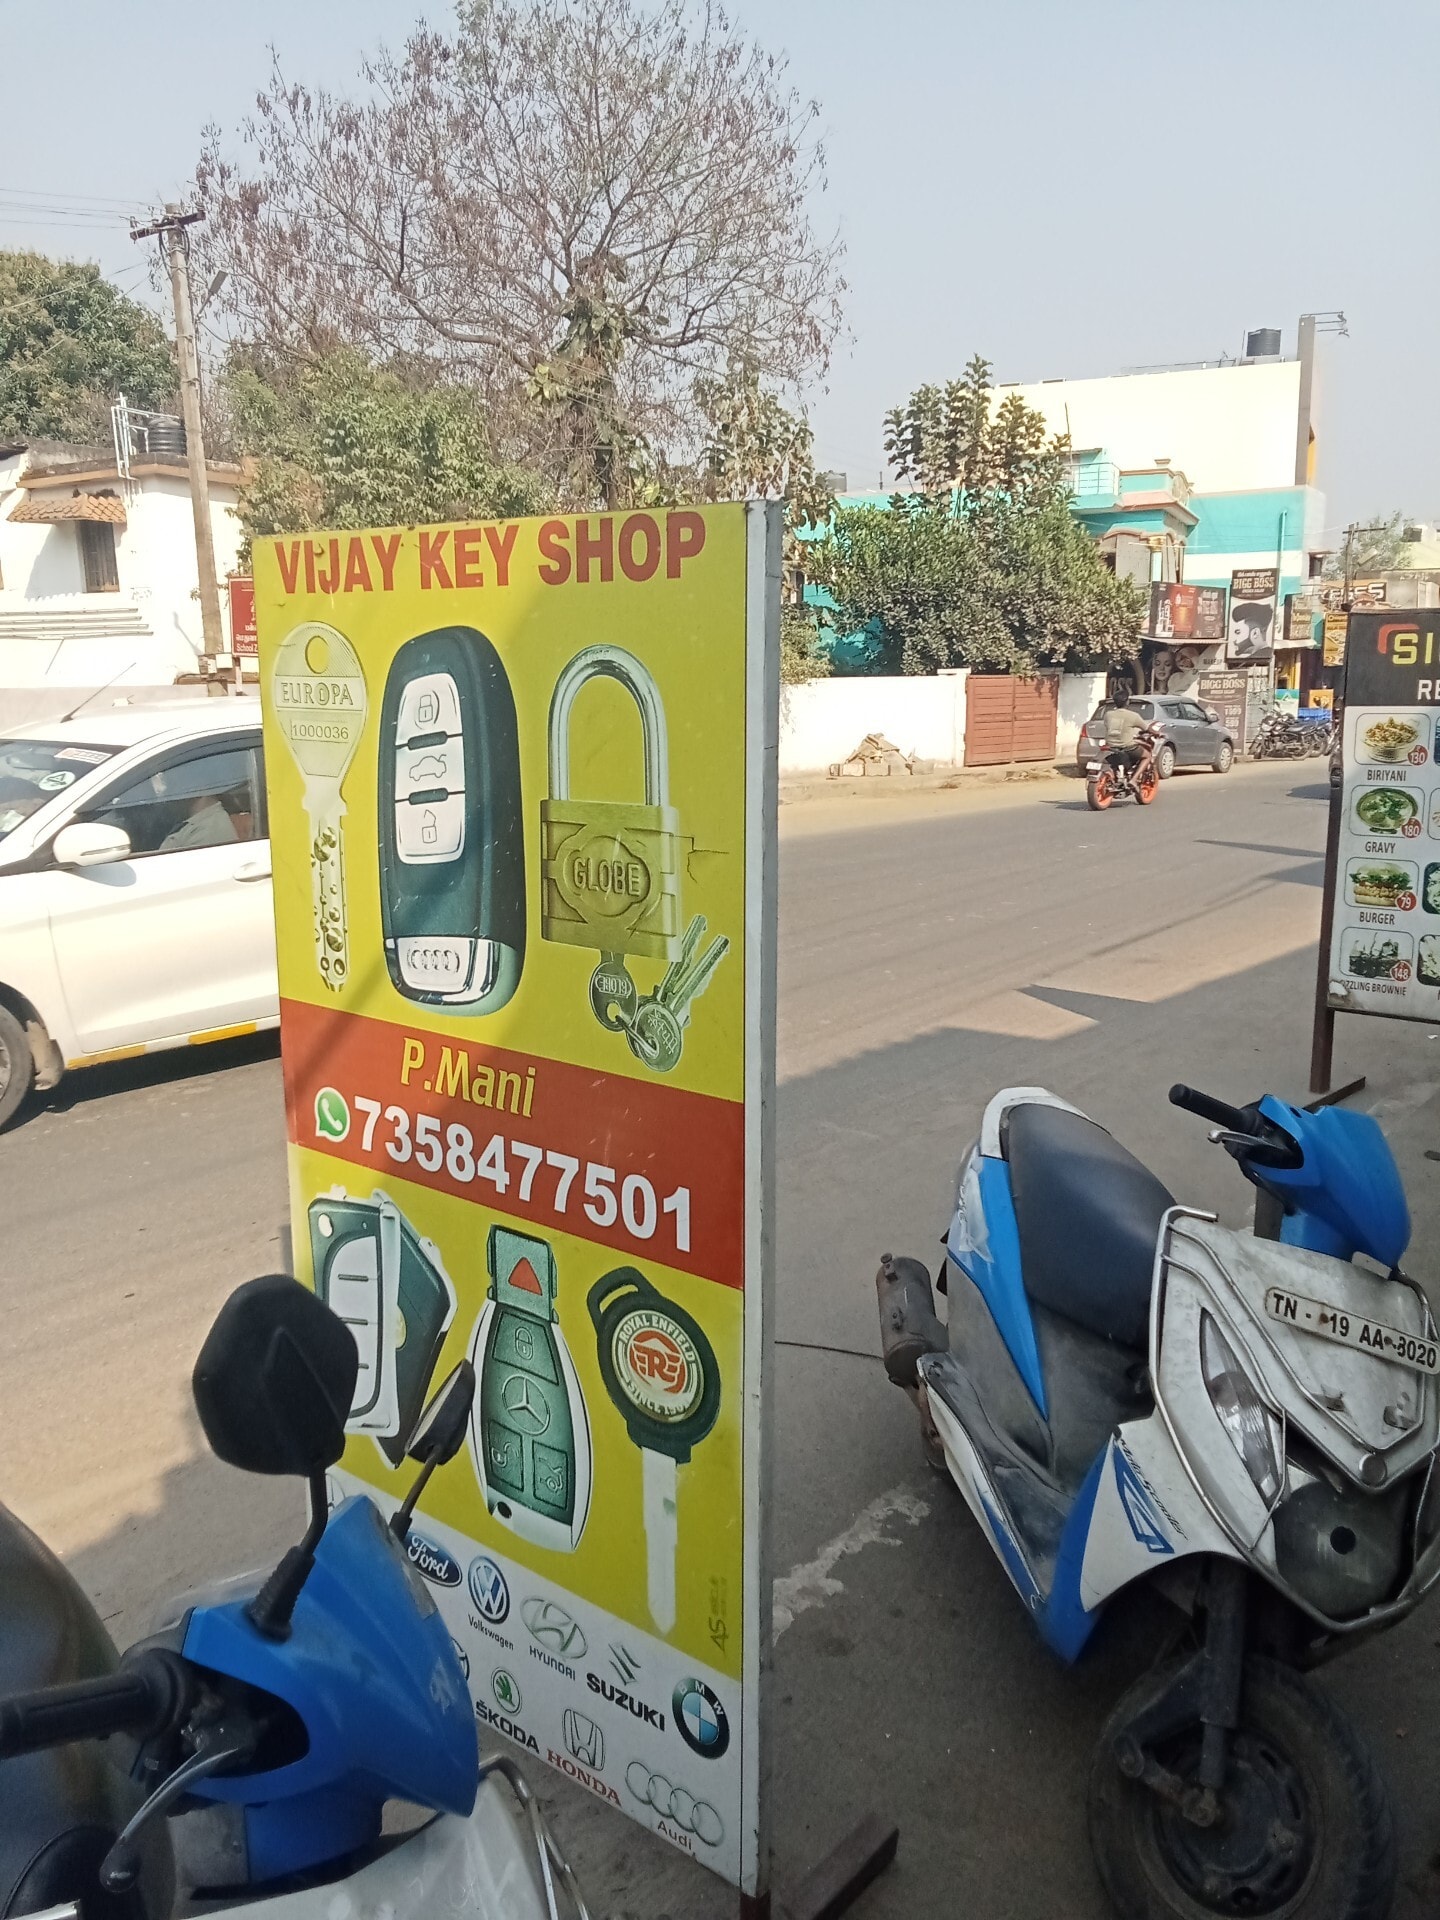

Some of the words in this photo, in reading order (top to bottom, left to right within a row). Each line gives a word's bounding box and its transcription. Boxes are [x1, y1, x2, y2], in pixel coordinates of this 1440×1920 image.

[274, 537, 401, 594] VIJAY
[420, 526, 517, 588] KEY
[539, 512, 705, 584] SHOP
[281, 682, 354, 706] EUROPA
[1200, 679, 1222, 690] BIGG
[1222, 678, 1246, 689] BOSS
[292, 724, 350, 741] 1000036
[1411, 751, 1426, 761] 130
[1367, 769, 1407, 782] BIRIYANI
[1365, 841, 1396, 854] GRAVY
[1404, 824, 1420, 836] 180
[574, 856, 641, 897] GLOBE
[1359, 911, 1396, 925] BURGER
[1400, 897, 1412, 909] 79
[1371, 982, 1407, 996] BROWNIE
[401, 1037, 537, 1118] P.Mani
[354, 1095, 691, 1253] 7358477501
[1273, 1293, 1298, 1320] TN
[1329, 1312, 1350, 1337] 19
[618, 1315, 650, 1343] ROYAL
[651, 1315, 697, 1364] ENFIELD
[407, 1534, 450, 1580] Ford
[467, 1613, 515, 1652] Volkswagen
[528, 1644, 577, 1682] HYUNDAI
[586, 1671, 666, 1733] SUZUKI
[679, 1680, 725, 1717] BMW
[546, 1747, 623, 1808] HONDA
[656, 1819, 694, 1852] Audi
